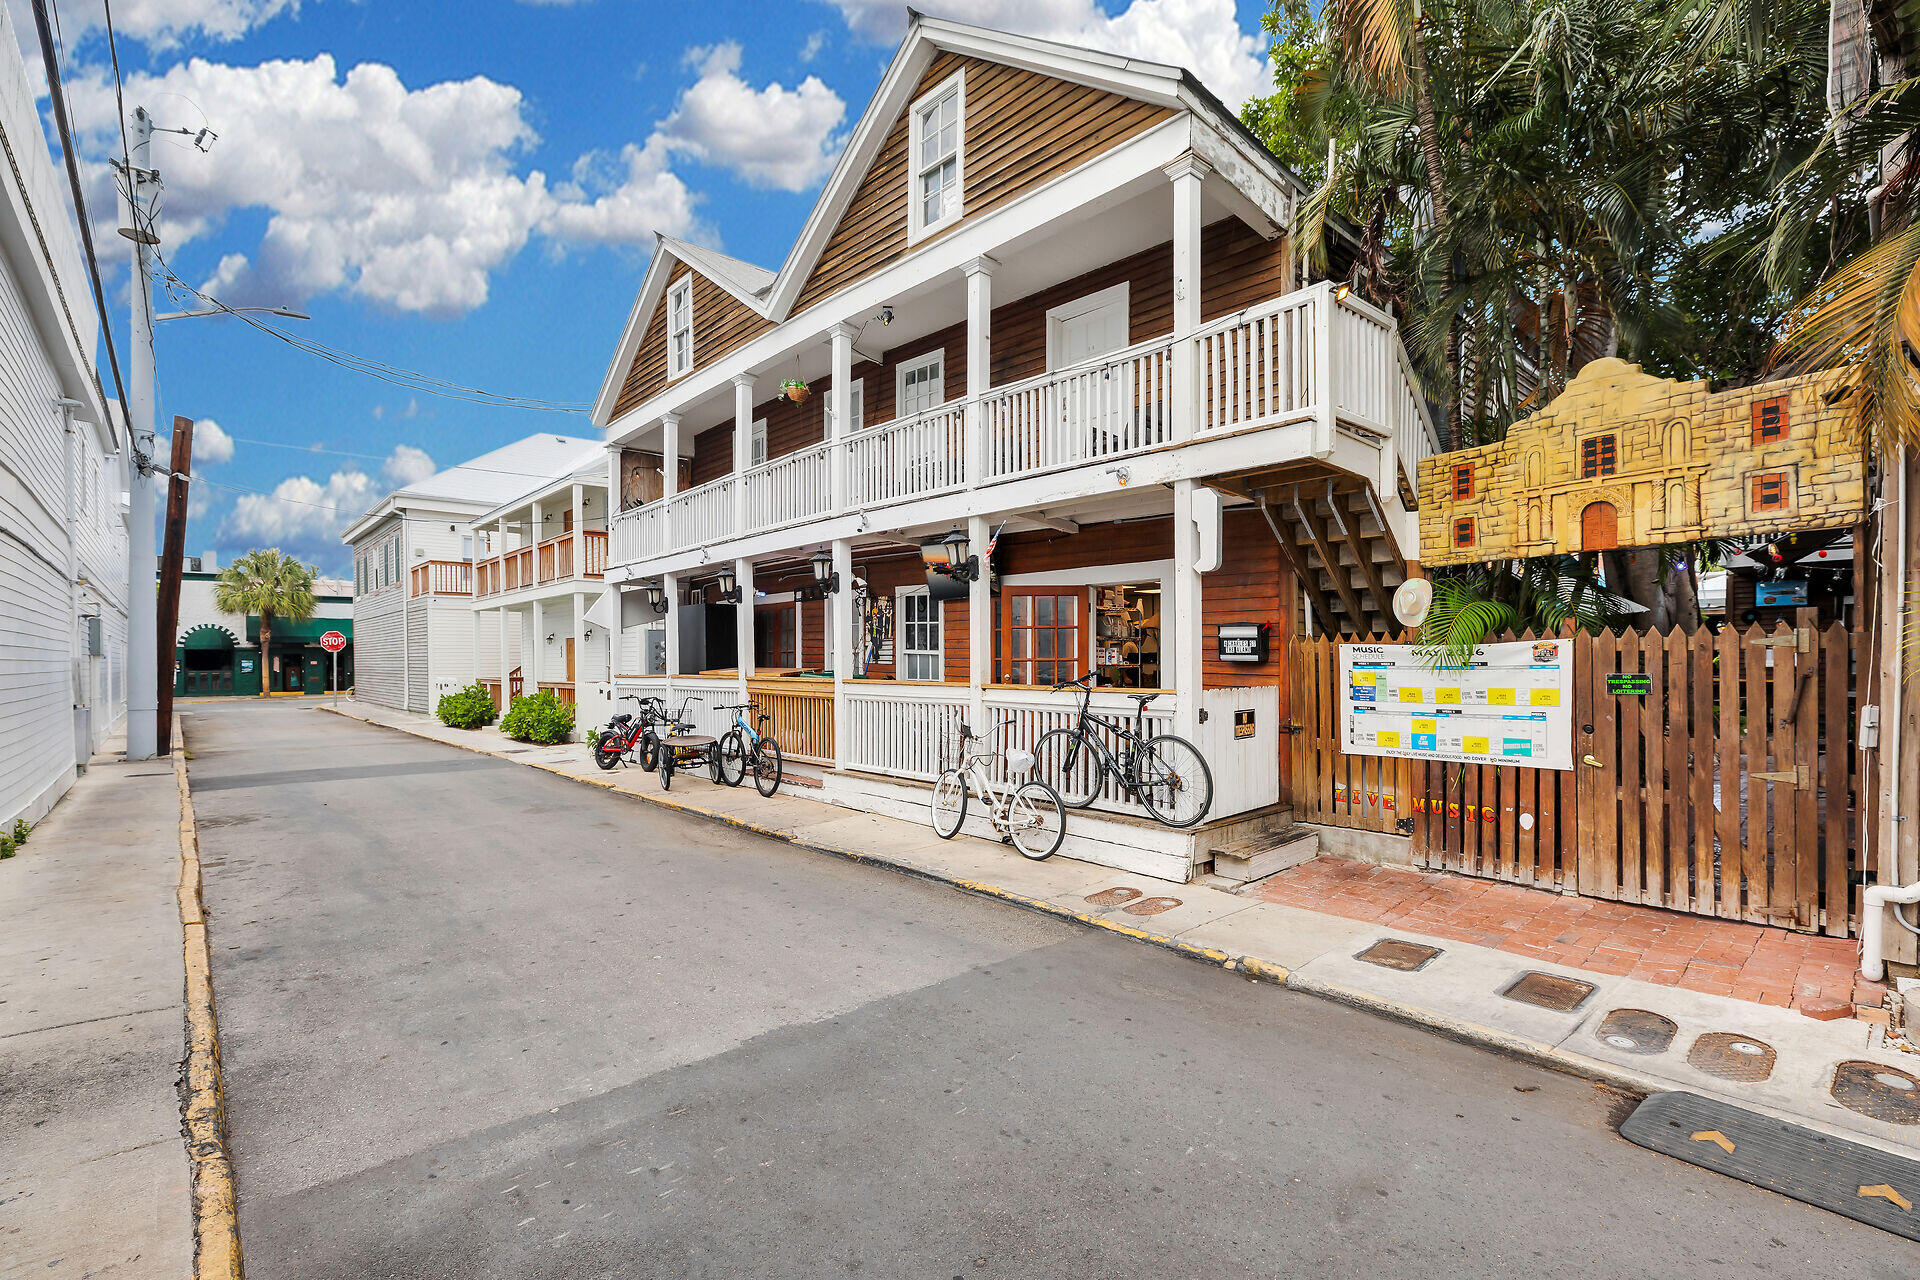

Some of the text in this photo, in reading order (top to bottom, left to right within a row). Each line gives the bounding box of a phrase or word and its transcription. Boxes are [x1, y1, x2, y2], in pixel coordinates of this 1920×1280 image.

[322, 637, 344, 646] STOP
[1335, 789, 1495, 823] LIVE MUSIC
